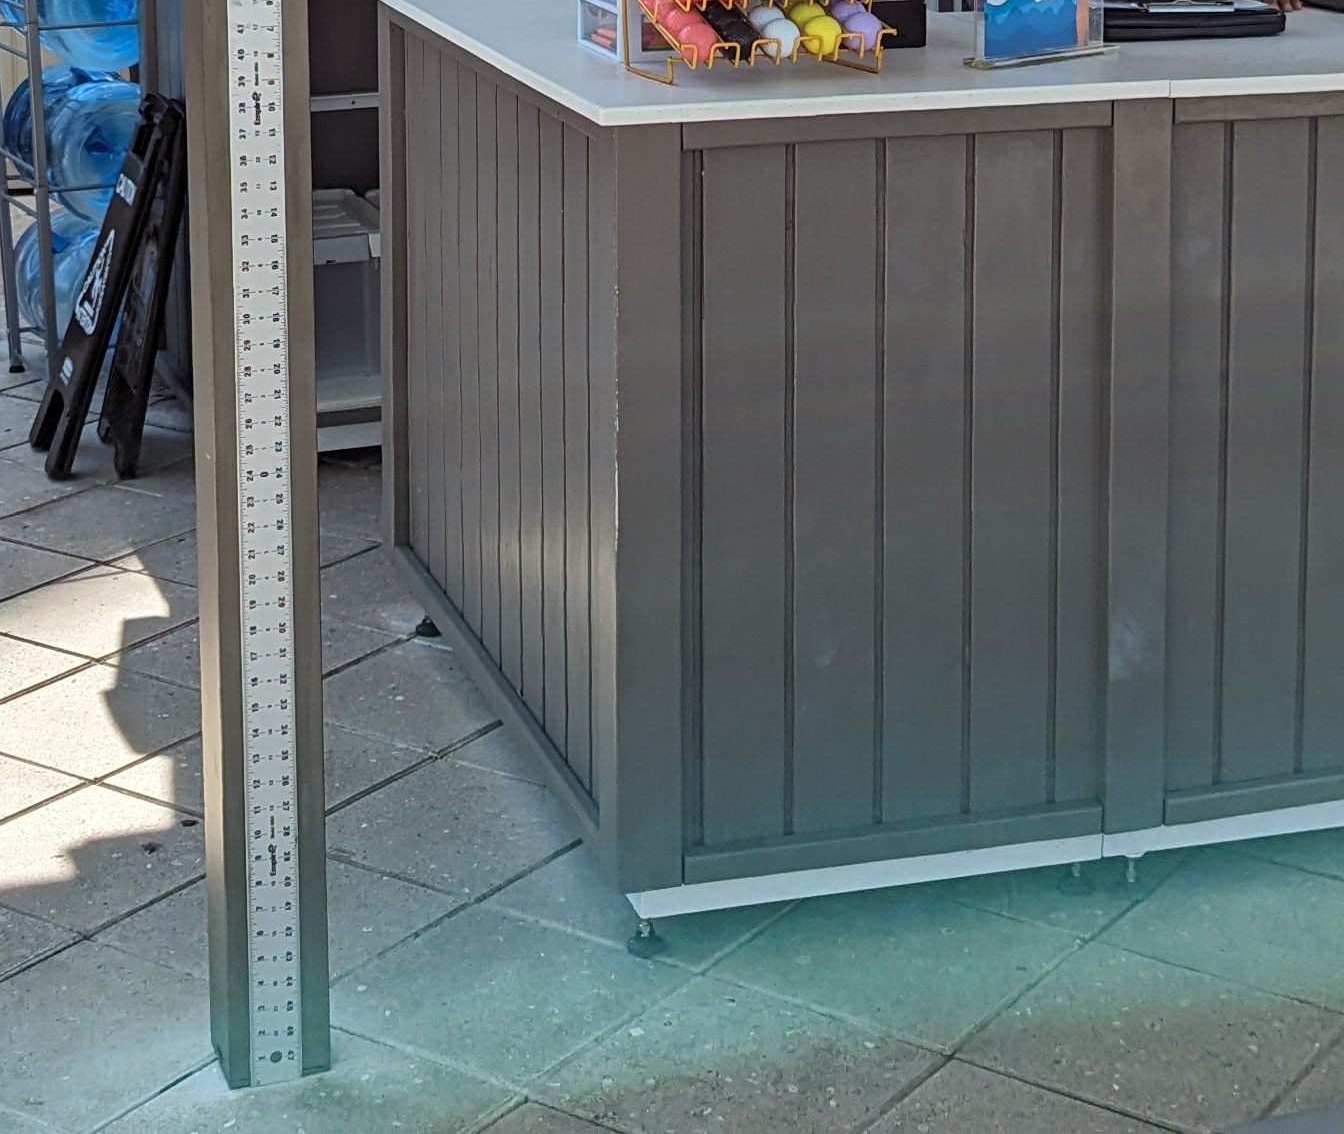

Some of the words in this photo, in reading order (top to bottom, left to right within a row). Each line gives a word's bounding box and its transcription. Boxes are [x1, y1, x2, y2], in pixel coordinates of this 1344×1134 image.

[268, 101, 275, 111] 10
[269, 128, 276, 136] 11
[269, 154, 276, 164] 12
[270, 180, 277, 191] 13
[270, 207, 278, 217] 14
[271, 234, 278, 243] 15
[271, 260, 279, 270] 16
[272, 286, 279, 295] 17
[272, 312, 280, 322] 18
[273, 338, 280, 348] 19
[274, 363, 281, 374] 20
[274, 389, 281, 399] 21
[275, 415, 282, 426] 22
[275, 441, 282, 452] 23
[276, 466, 283, 478] 24
[276, 493, 283, 504] 25
[277, 519, 284, 530] 26
[277, 544, 284, 555] 27
[278, 570, 285, 582] 28
[278, 596, 285, 608] 29
[279, 622, 286, 633] 30
[279, 647, 286, 658] 31
[280, 673, 287, 684] 32
[280, 698, 287, 710] 33
[281, 724, 288, 735] 34
[281, 749, 288, 761] 35
[282, 775, 289, 786] 36
[282, 800, 289, 811] 37
[283, 825, 290, 836] 38
[283, 850, 290, 862] 39
[284, 875, 291, 887] 40
[284, 901, 291, 910] 41
[285, 926, 292, 937] 42
[285, 951, 292, 962] 43
[287, 1049, 294, 1060] 47
